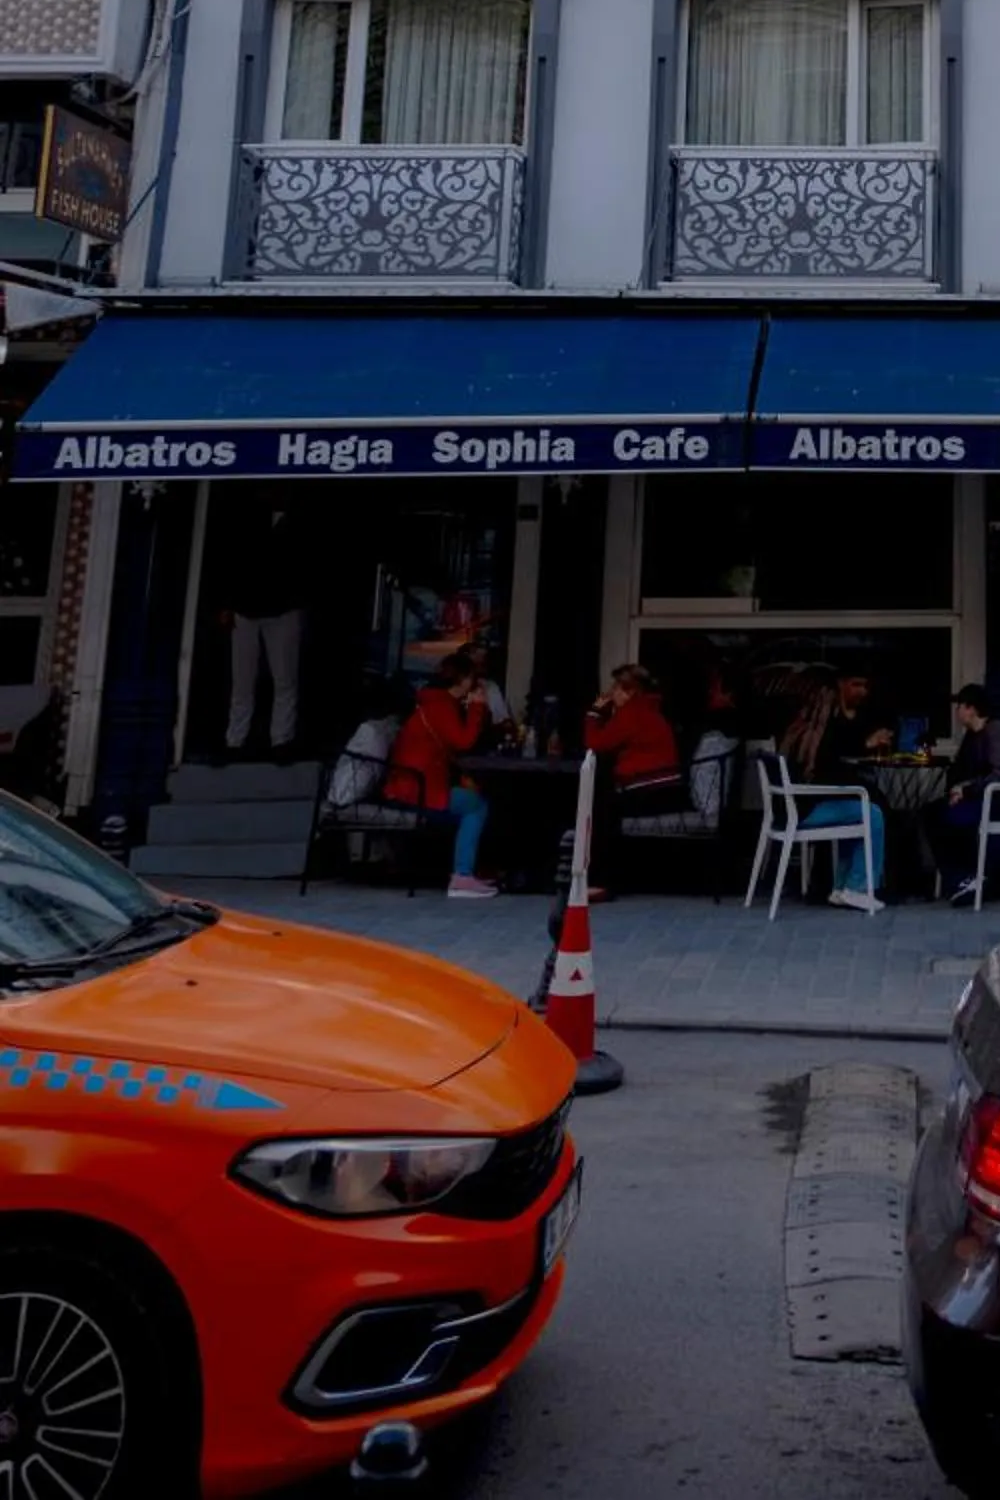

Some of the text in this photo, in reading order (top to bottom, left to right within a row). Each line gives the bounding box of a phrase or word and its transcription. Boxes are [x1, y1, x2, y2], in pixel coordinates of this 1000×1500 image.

[51, 188, 120, 236] FISH HOUSE
[53, 435, 237, 470] Albatros
[432, 430, 576, 469] Sophia
[613, 427, 710, 461] Cafe
[789, 427, 966, 461] Albatros
